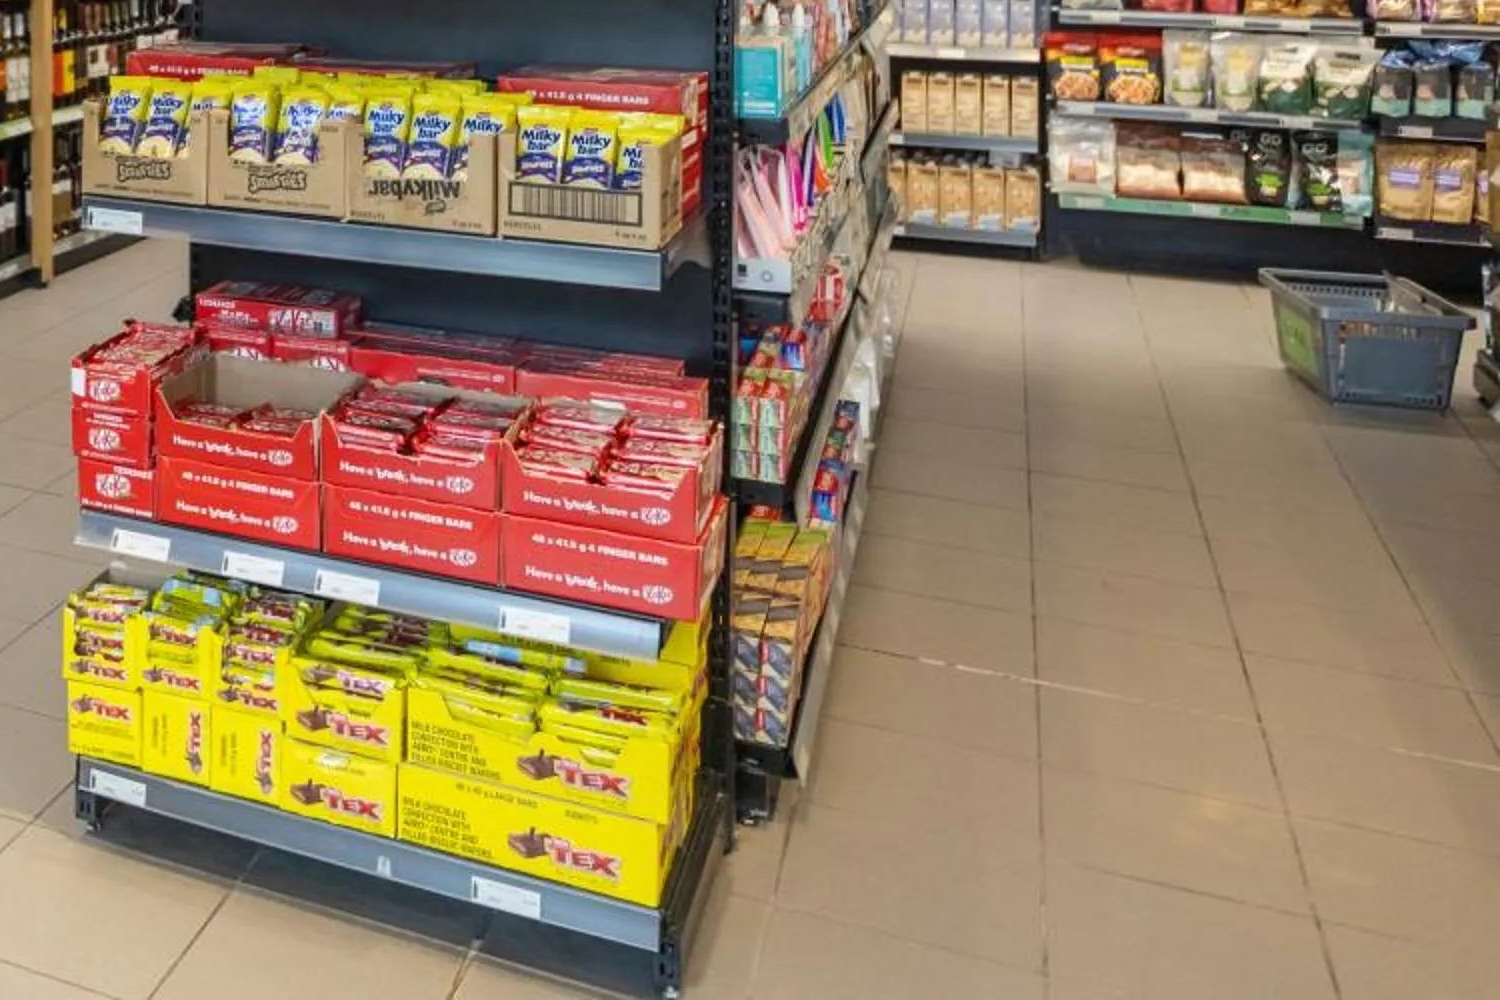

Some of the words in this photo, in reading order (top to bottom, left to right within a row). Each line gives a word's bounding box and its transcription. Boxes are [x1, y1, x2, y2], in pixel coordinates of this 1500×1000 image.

[585, 93, 621, 104] FINGER
[622, 95, 650, 106] BARS
[414, 117, 452, 131] Milky
[463, 119, 504, 133] Milky
[521, 128, 561, 144] Milky
[526, 137, 549, 151] bar
[571, 133, 611, 149] Milky
[577, 143, 601, 155] bar
[367, 179, 461, 200] Milkybar
[173, 434, 196, 447] Have
[237, 449, 260, 460] have
[340, 461, 365, 475] Have
[411, 473, 436, 487] have
[176, 500, 200, 512] Have
[241, 515, 263, 526] have
[348, 501, 362, 511] 48
[408, 511, 445, 525] FINGER
[446, 518, 473, 531] BARS
[523, 491, 552, 504] Have
[601, 505, 629, 519] have
[343, 531, 369, 546] Have
[414, 544, 439, 559] have
[532, 533, 546, 543] 48
[597, 545, 636, 561] FINGER
[637, 553, 669, 567] BARS
[525, 565, 554, 580] Have
[603, 581, 630, 596] have
[91, 664, 127, 681] TEX
[162, 674, 200, 691] TEX
[92, 702, 131, 721] TEX
[240, 694, 278, 712] TEX
[335, 719, 389, 748] TEX
[562, 767, 629, 800] TEX
[327, 794, 382, 821] TEX
[553, 845, 620, 879] TEX
